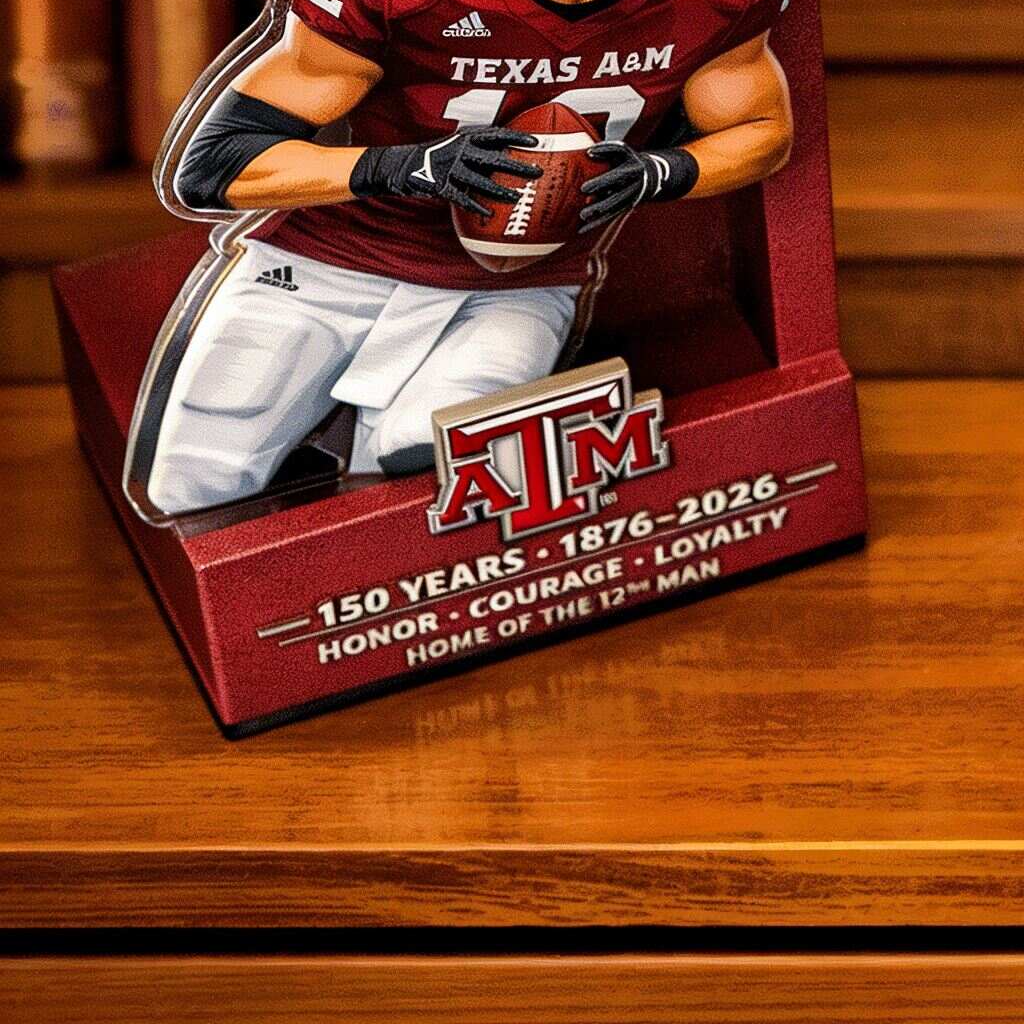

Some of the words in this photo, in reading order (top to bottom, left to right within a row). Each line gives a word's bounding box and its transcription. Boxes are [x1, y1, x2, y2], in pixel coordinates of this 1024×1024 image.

[450, 56, 582, 84] TEXAS
[592, 44, 676, 80] A&M
[317, 612, 440, 665] HONOR
[468, 557, 624, 619] COURAGE
[654, 507, 788, 566] LOYALTY
[317, 587, 390, 627] 150
[398, 547, 526, 603] YEARS
[406, 626, 491, 667] HOME
[497, 612, 533, 638] OF
[538, 595, 593, 626] THE
[656, 557, 721, 593] MAN
